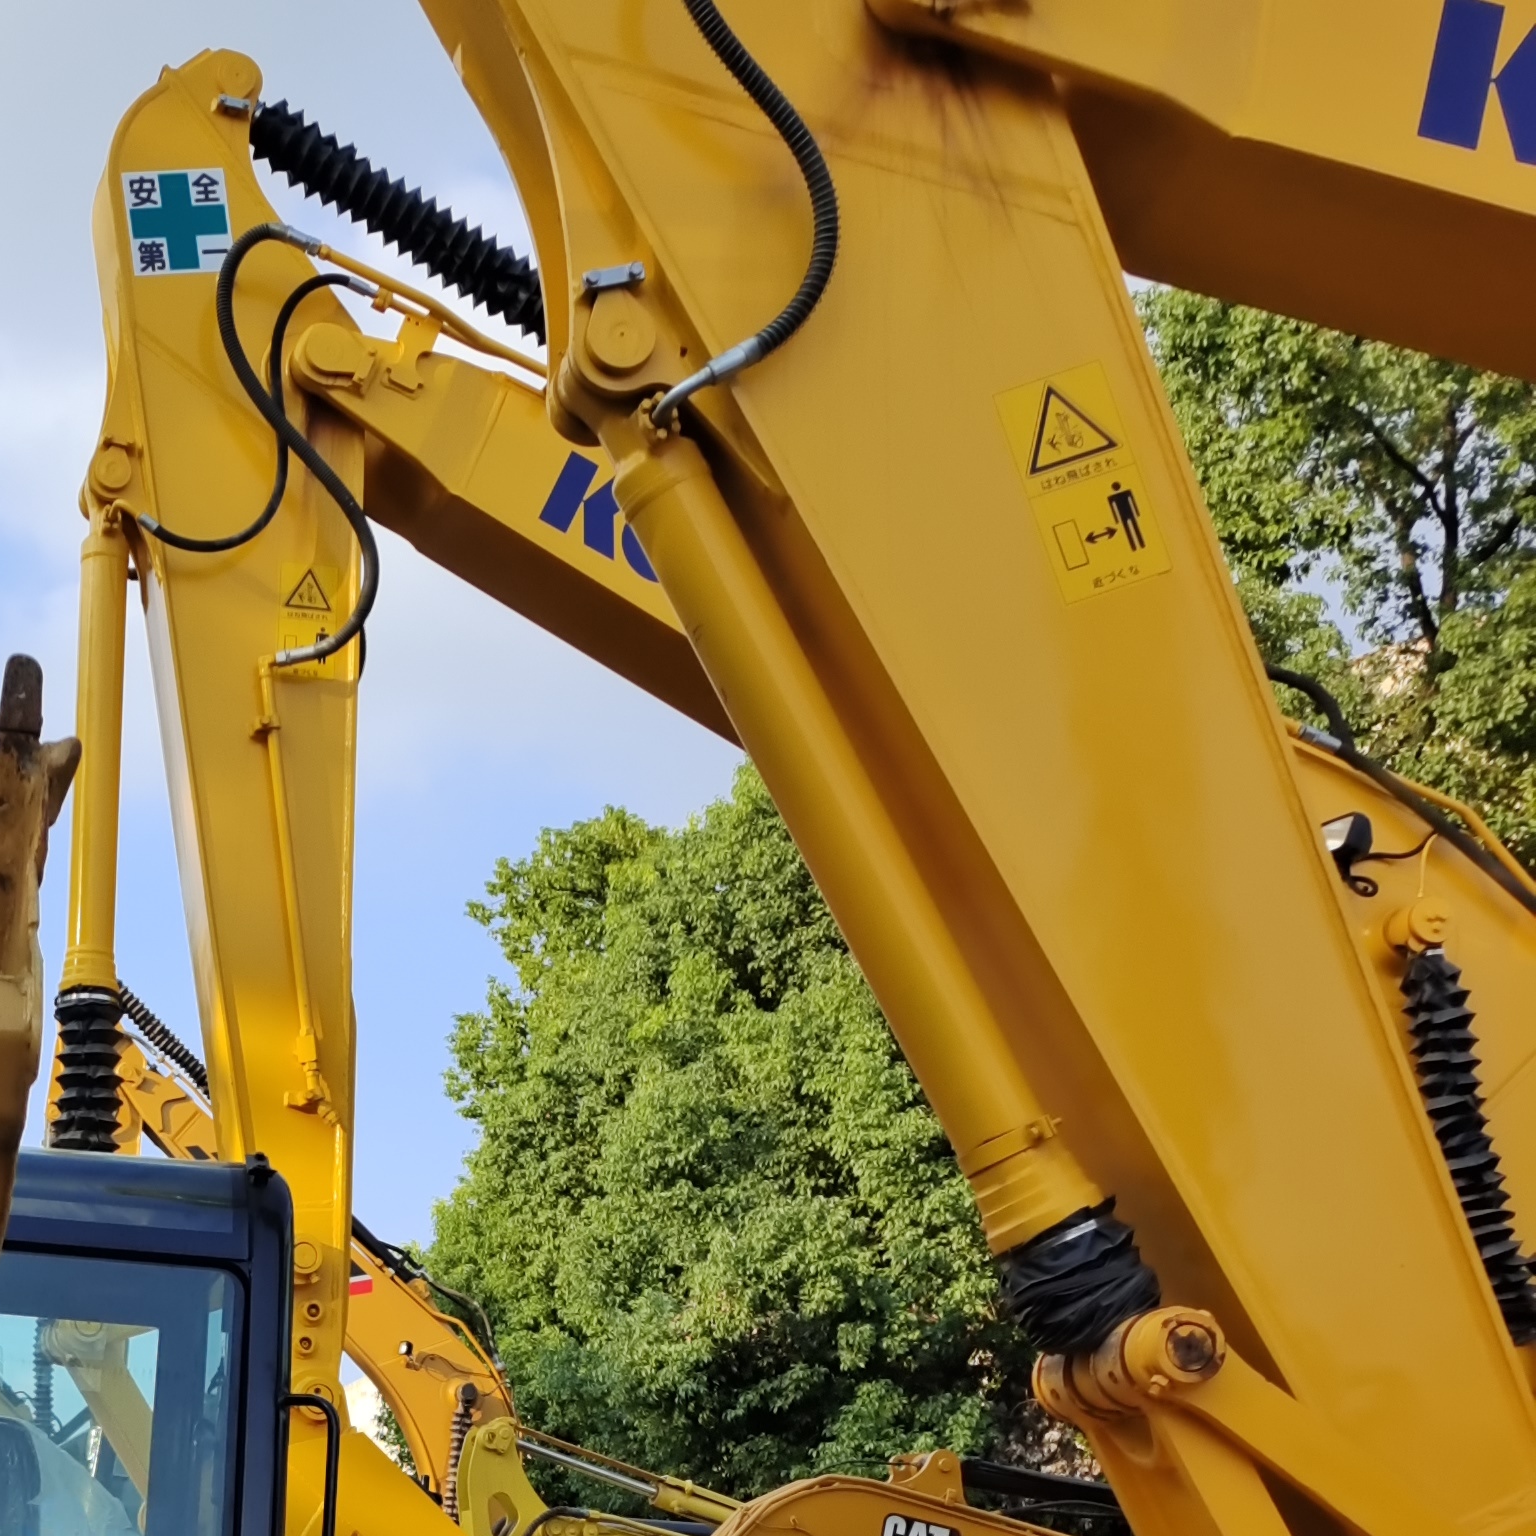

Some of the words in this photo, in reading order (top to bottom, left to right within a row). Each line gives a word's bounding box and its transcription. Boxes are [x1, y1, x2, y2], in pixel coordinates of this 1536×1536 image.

[129, 176, 158, 207] 安
[192, 173, 220, 203] 全
[138, 240, 166, 272] 第
